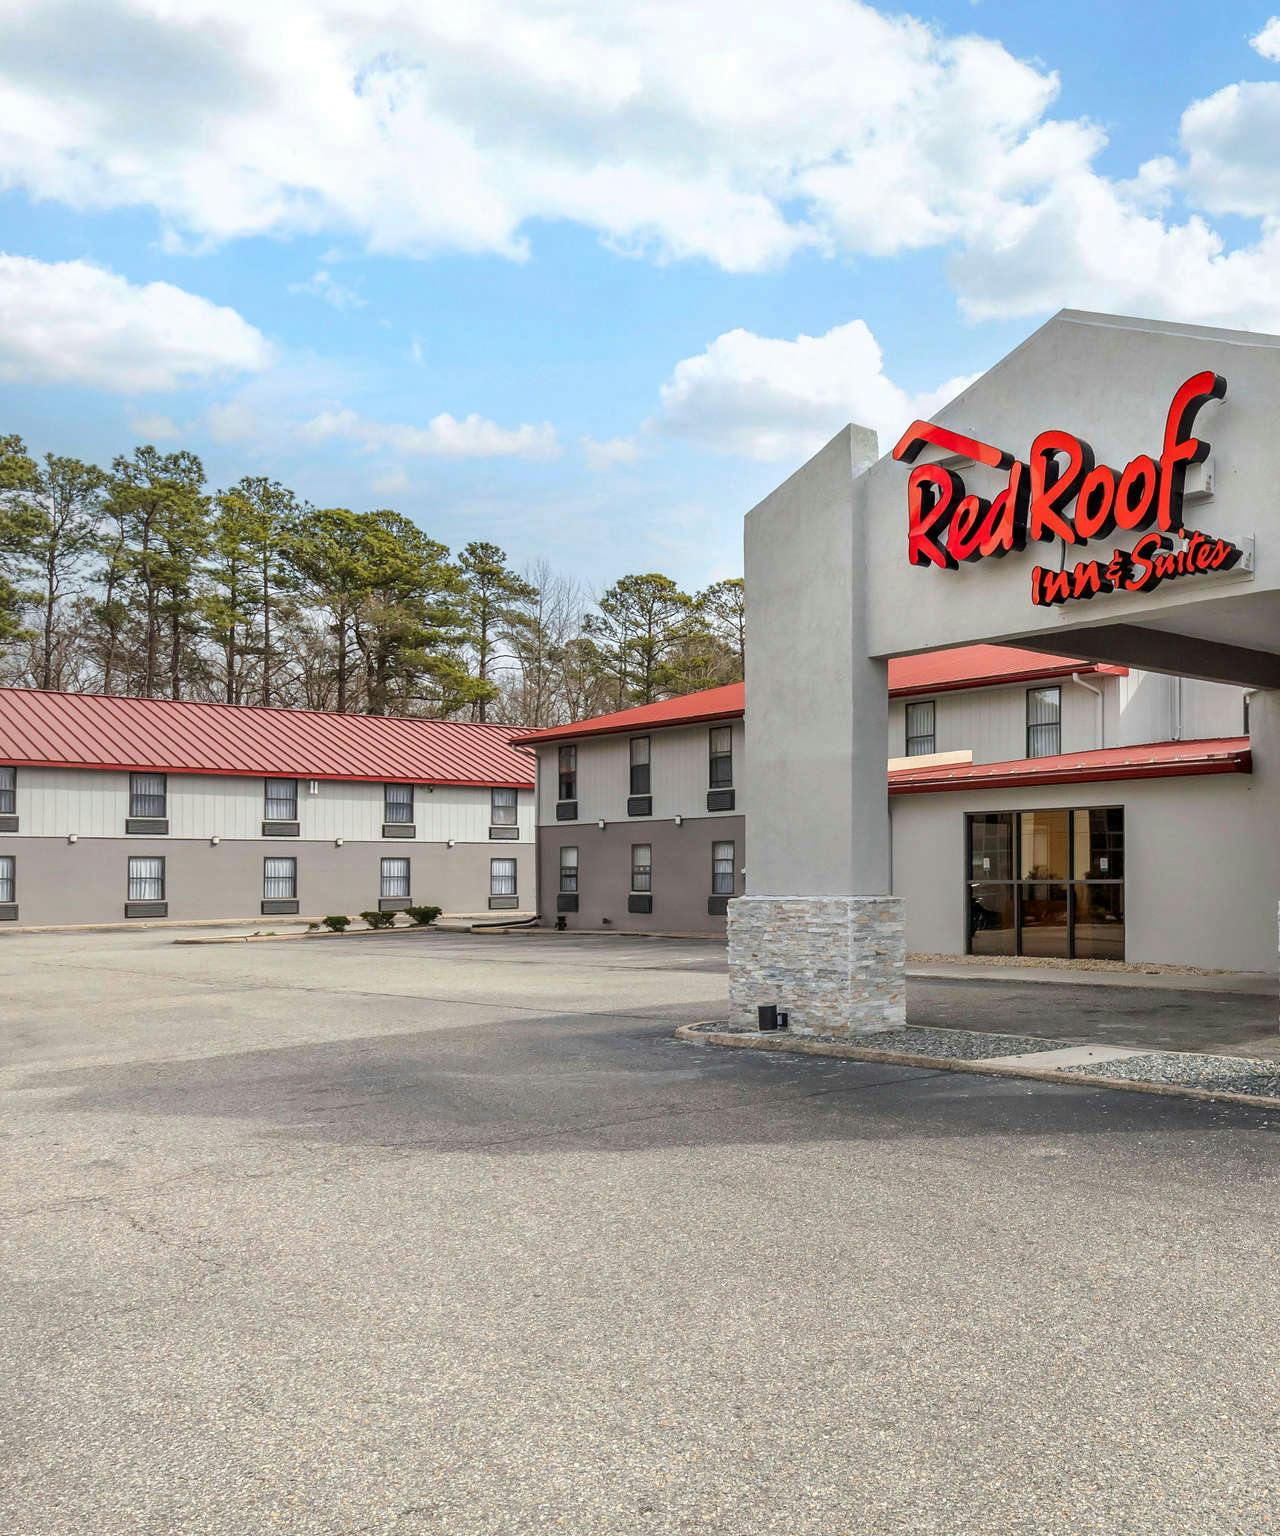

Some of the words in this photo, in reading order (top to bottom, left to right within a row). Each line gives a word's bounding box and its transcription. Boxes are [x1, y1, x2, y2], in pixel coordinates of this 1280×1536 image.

[907, 461, 1024, 570] Red
[1029, 370, 1218, 545] Roof
[1031, 559, 1102, 606] Inn
[1105, 549, 1124, 589] &
[1125, 528, 1233, 592] Suites
